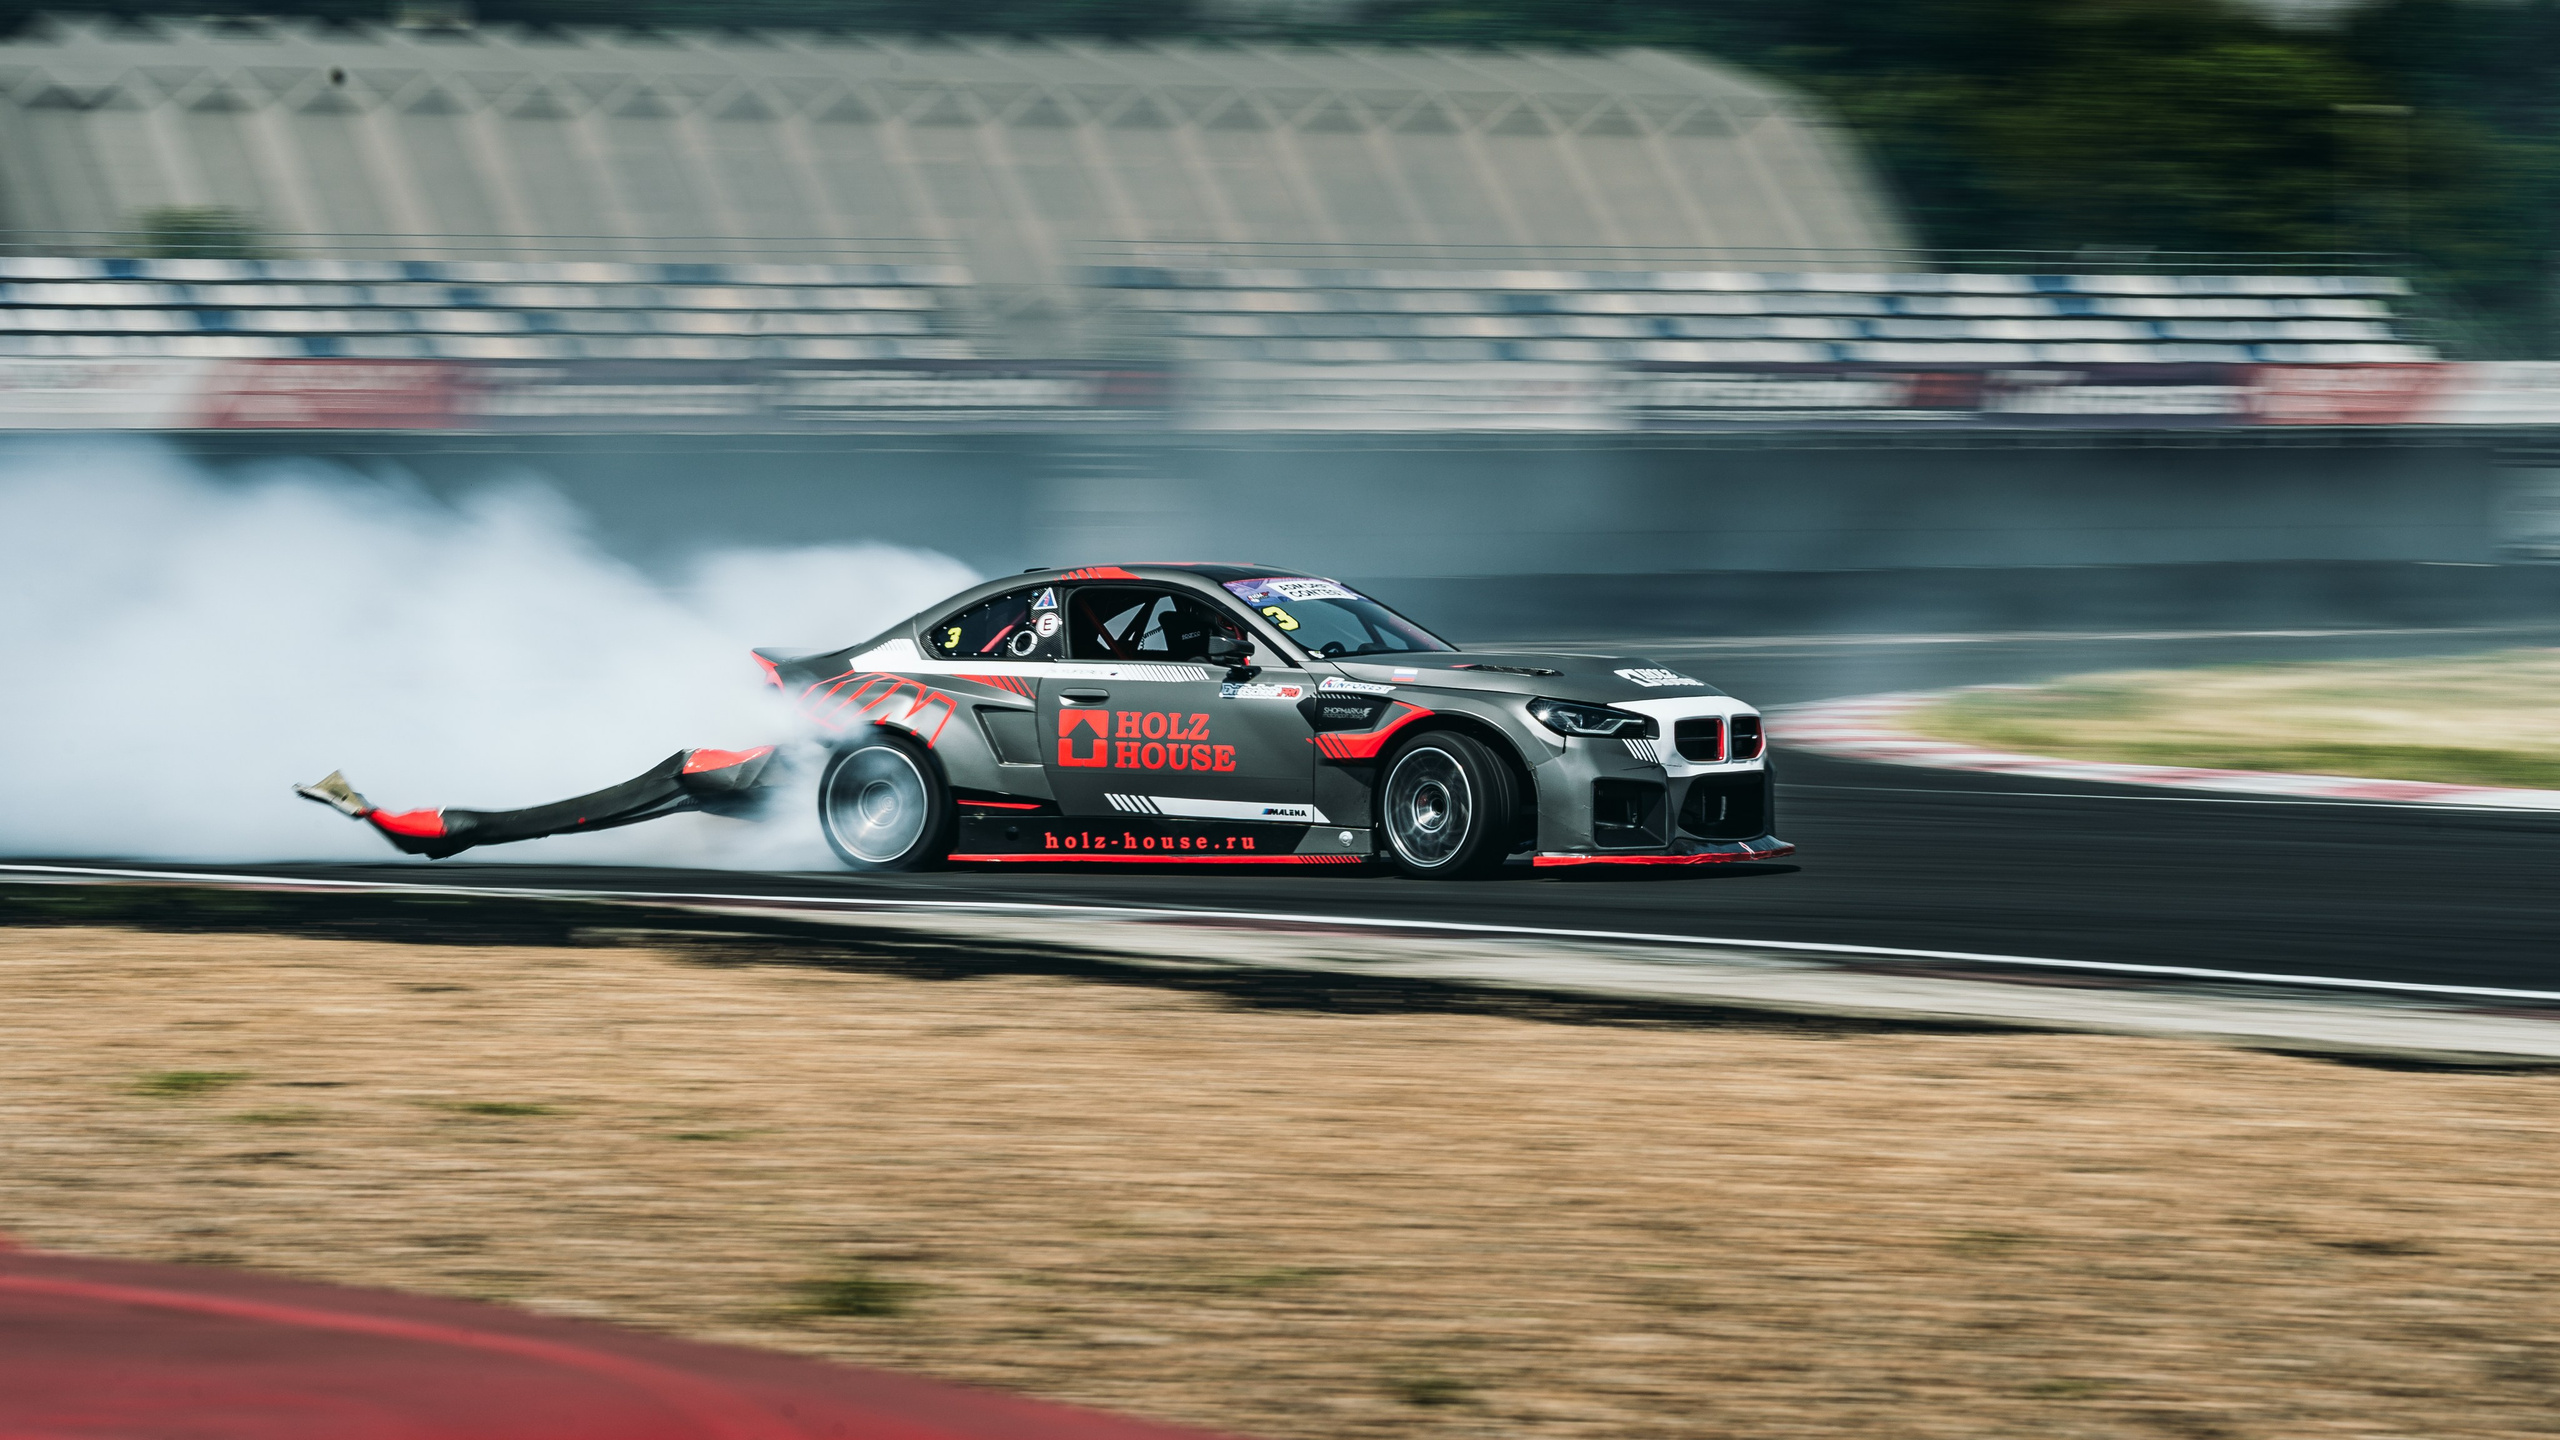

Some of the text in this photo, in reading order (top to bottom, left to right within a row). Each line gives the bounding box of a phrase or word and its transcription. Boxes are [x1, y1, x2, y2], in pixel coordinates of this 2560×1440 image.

[1043, 617, 1053, 631] E
[1260, 605, 1301, 631] 3
[944, 627, 962, 649] 3
[1115, 711, 1210, 740] HOLZ
[1115, 741, 1237, 772] HOUSE
[1045, 832, 1255, 850] holz-house.ru
